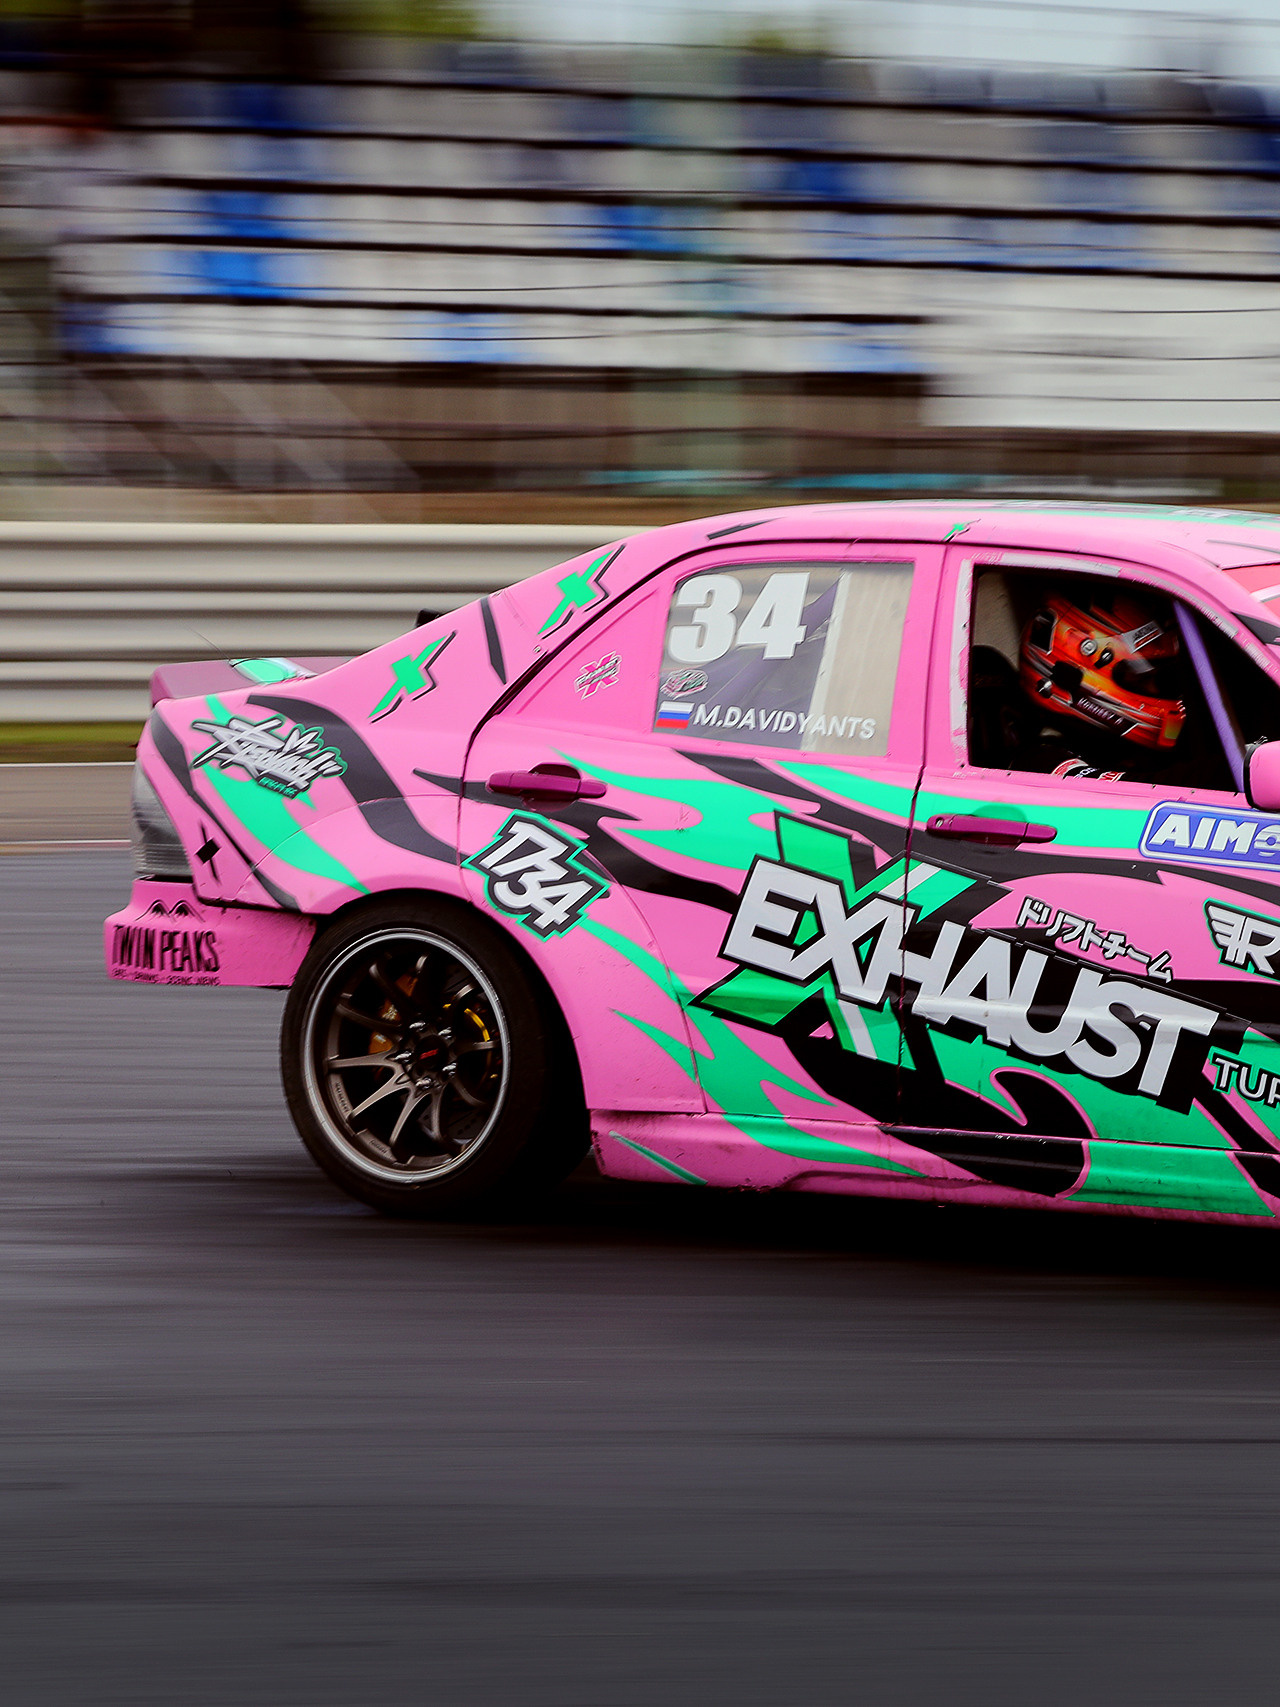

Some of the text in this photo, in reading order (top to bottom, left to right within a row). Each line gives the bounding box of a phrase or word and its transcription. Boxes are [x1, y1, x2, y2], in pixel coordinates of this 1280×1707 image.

[668, 572, 810, 665] 34
[693, 703, 876, 739] M.DAVIDYANTS
[479, 821, 593, 930] 1734
[112, 925, 220, 973] TWIN PEAKS
[723, 859, 1219, 1097] EXHAUST
[1017, 898, 1172, 984] ドリフトチーム
